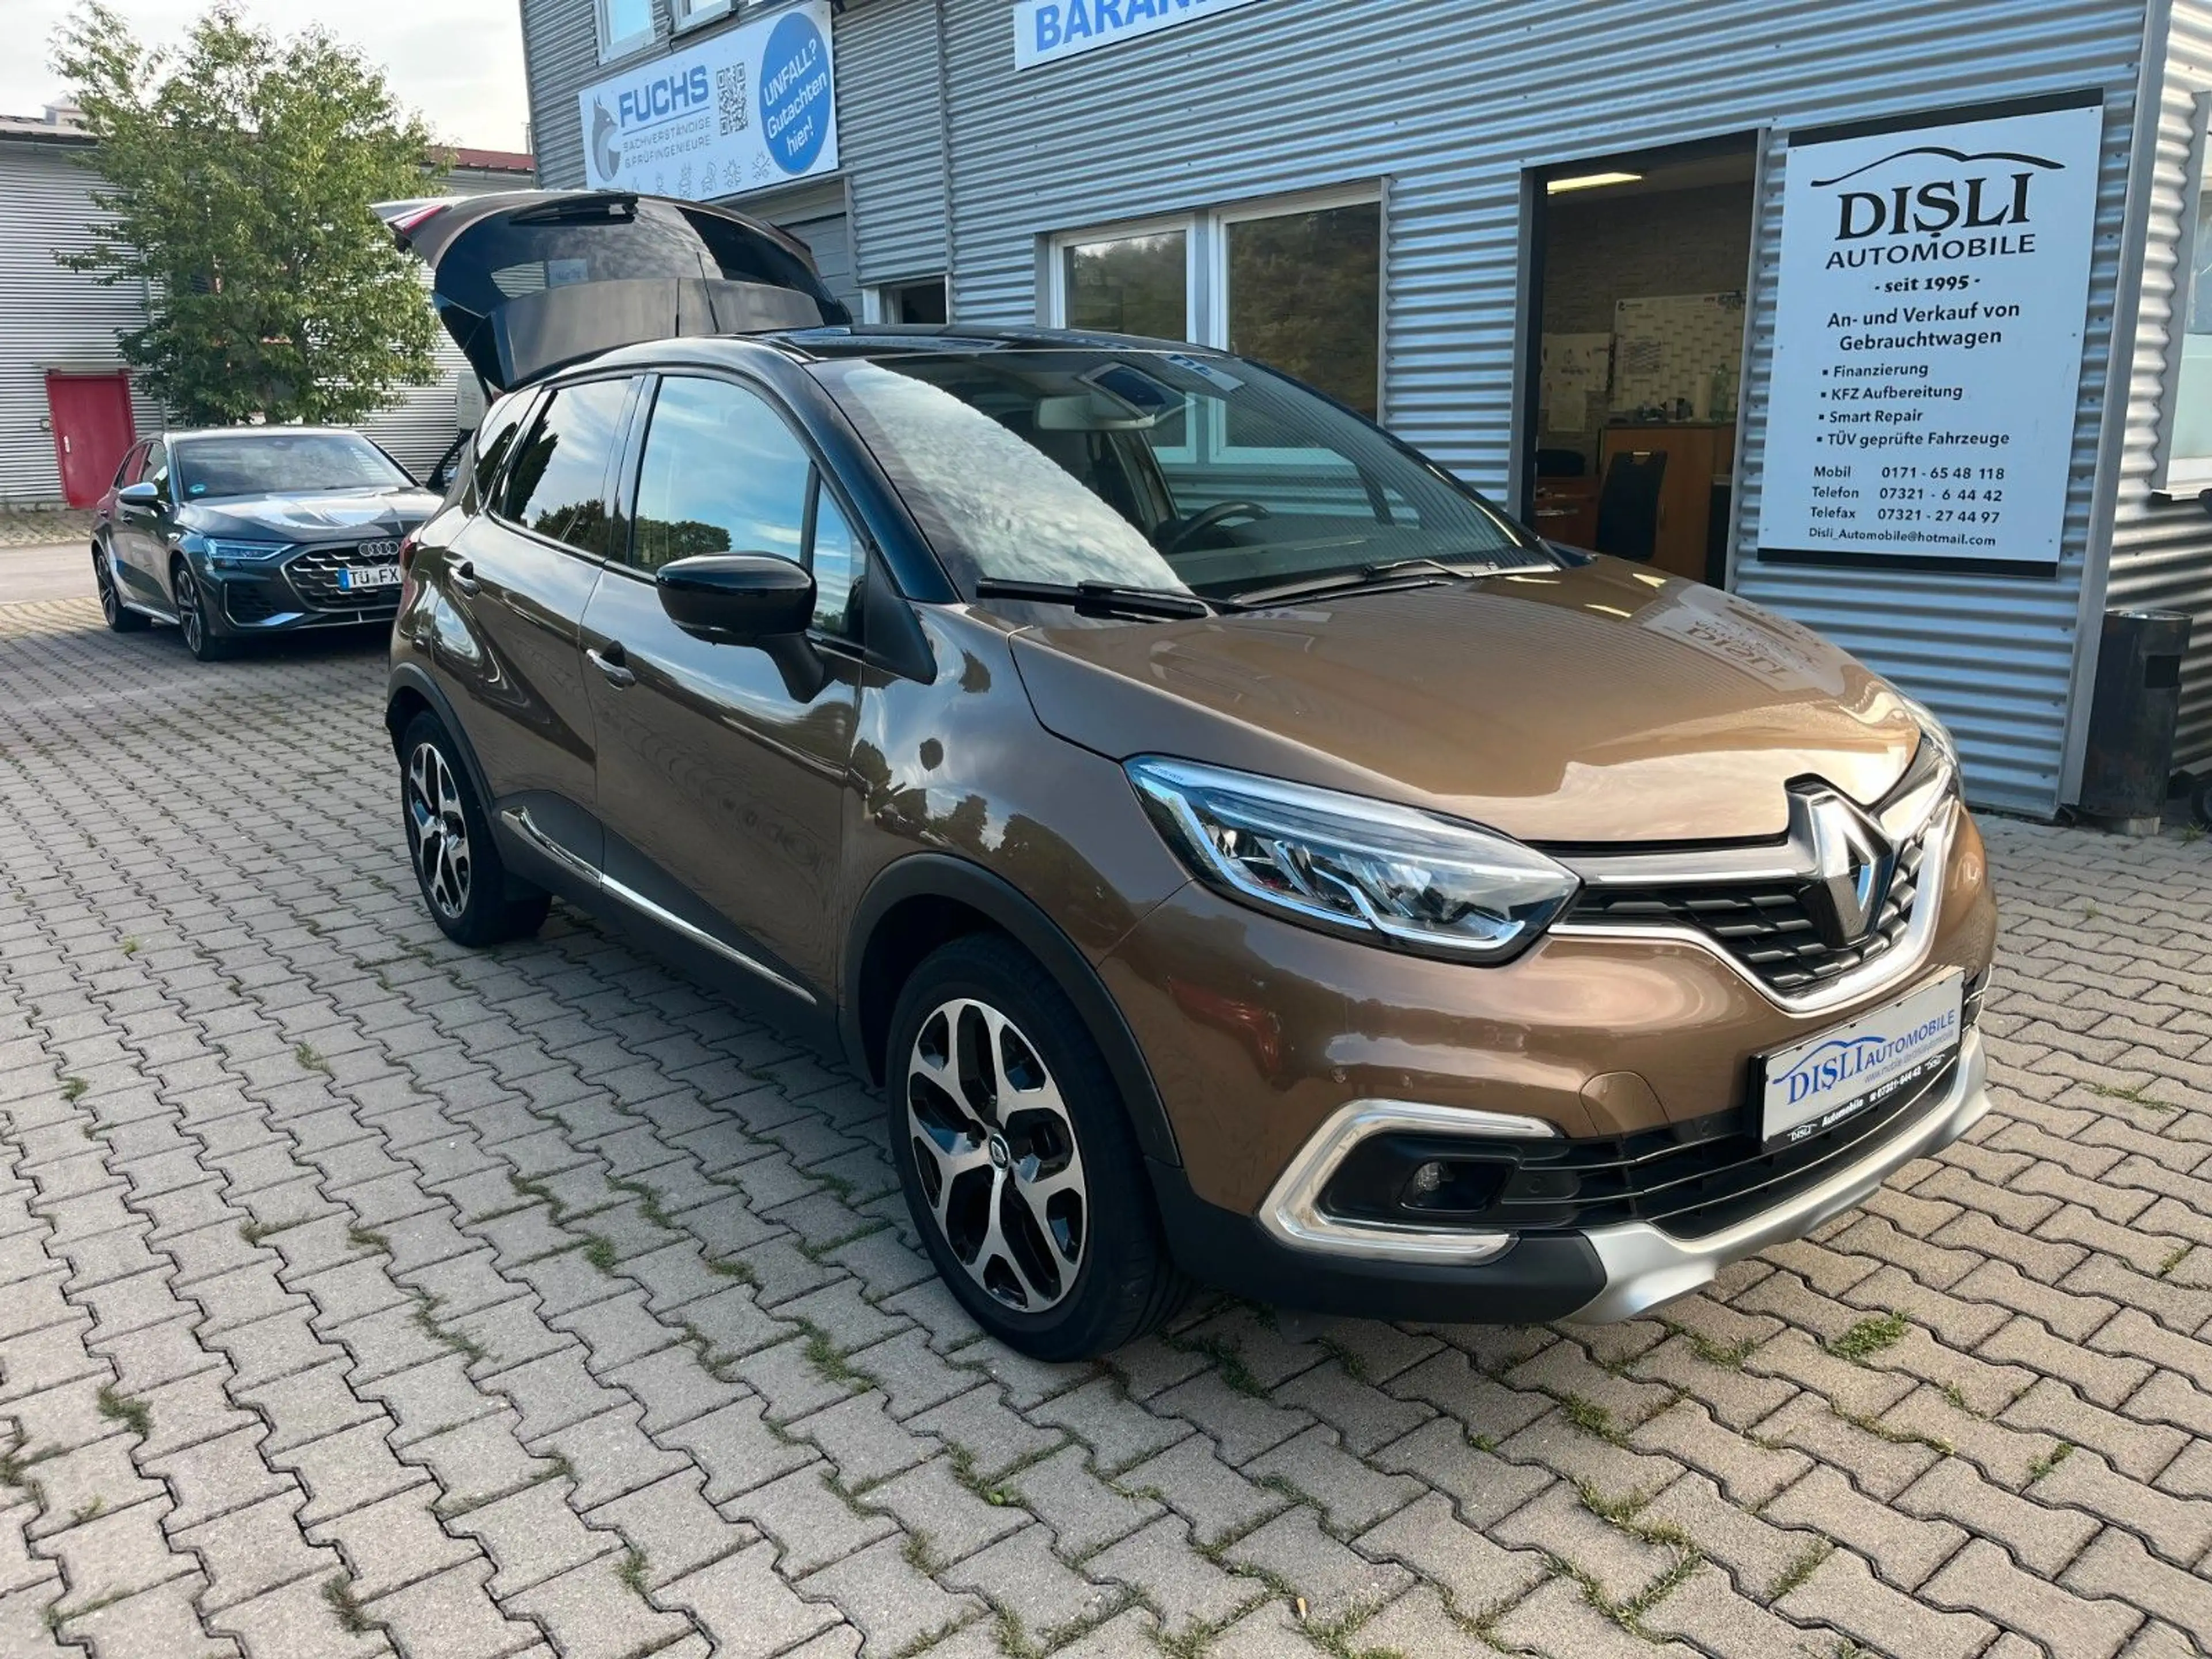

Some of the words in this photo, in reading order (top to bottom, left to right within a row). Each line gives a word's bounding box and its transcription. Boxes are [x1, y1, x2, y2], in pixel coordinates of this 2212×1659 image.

[764, 39, 817, 106] UNFALL?
[619, 65, 709, 128] FUCHS
[767, 71, 828, 139] Gutachten
[786, 115, 814, 156] hier!
[1825, 233, 2036, 270] AUTOMOBILE
[1884, 277, 1919, 293] seit
[1925, 275, 1969, 291] 1995
[1827, 313, 1858, 328] An-
[1863, 308, 1898, 325] und
[1903, 301, 1979, 323] Verkauf
[1983, 304, 2020, 318] von
[1839, 331, 2002, 351] Gebrauchtwagen
[1834, 363, 1929, 378] Finanzierung
[1831, 388, 1859, 400] KFZ
[1862, 385, 1963, 400] Aufbereitung
[1829, 411, 1871, 423] Smart
[1874, 408, 1923, 425] Repair
[1828, 430, 1857, 446] TÜV
[1859, 433, 1923, 449] geprüfte
[1928, 431, 2010, 448] Fahrzeuge
[1813, 465, 1851, 478] Mobil
[1881, 467, 1916, 479] 0171
[1930, 467, 1948, 479] 65
[1952, 467, 1971, 479] 48
[1979, 468, 2005, 480] 118
[1812, 486, 1859, 499] Telefon
[1879, 487, 1924, 500] 07321
[1942, 488, 1950, 501] 6
[1957, 489, 1976, 501] 44
[1983, 490, 2003, 502] 42
[1810, 506, 1856, 519] Telefax
[1877, 509, 1922, 521] 07321
[1935, 510, 1954, 522] 27
[1957, 510, 1976, 523] 44
[1980, 512, 2000, 524] 97
[1809, 528, 1997, 547] Disli_Automobile@hotmail.com
[349, 570, 370, 586] TÜ
[379, 568, 399, 583] FX
[1865, 1009, 1955, 1070] AUTOMOBILE
